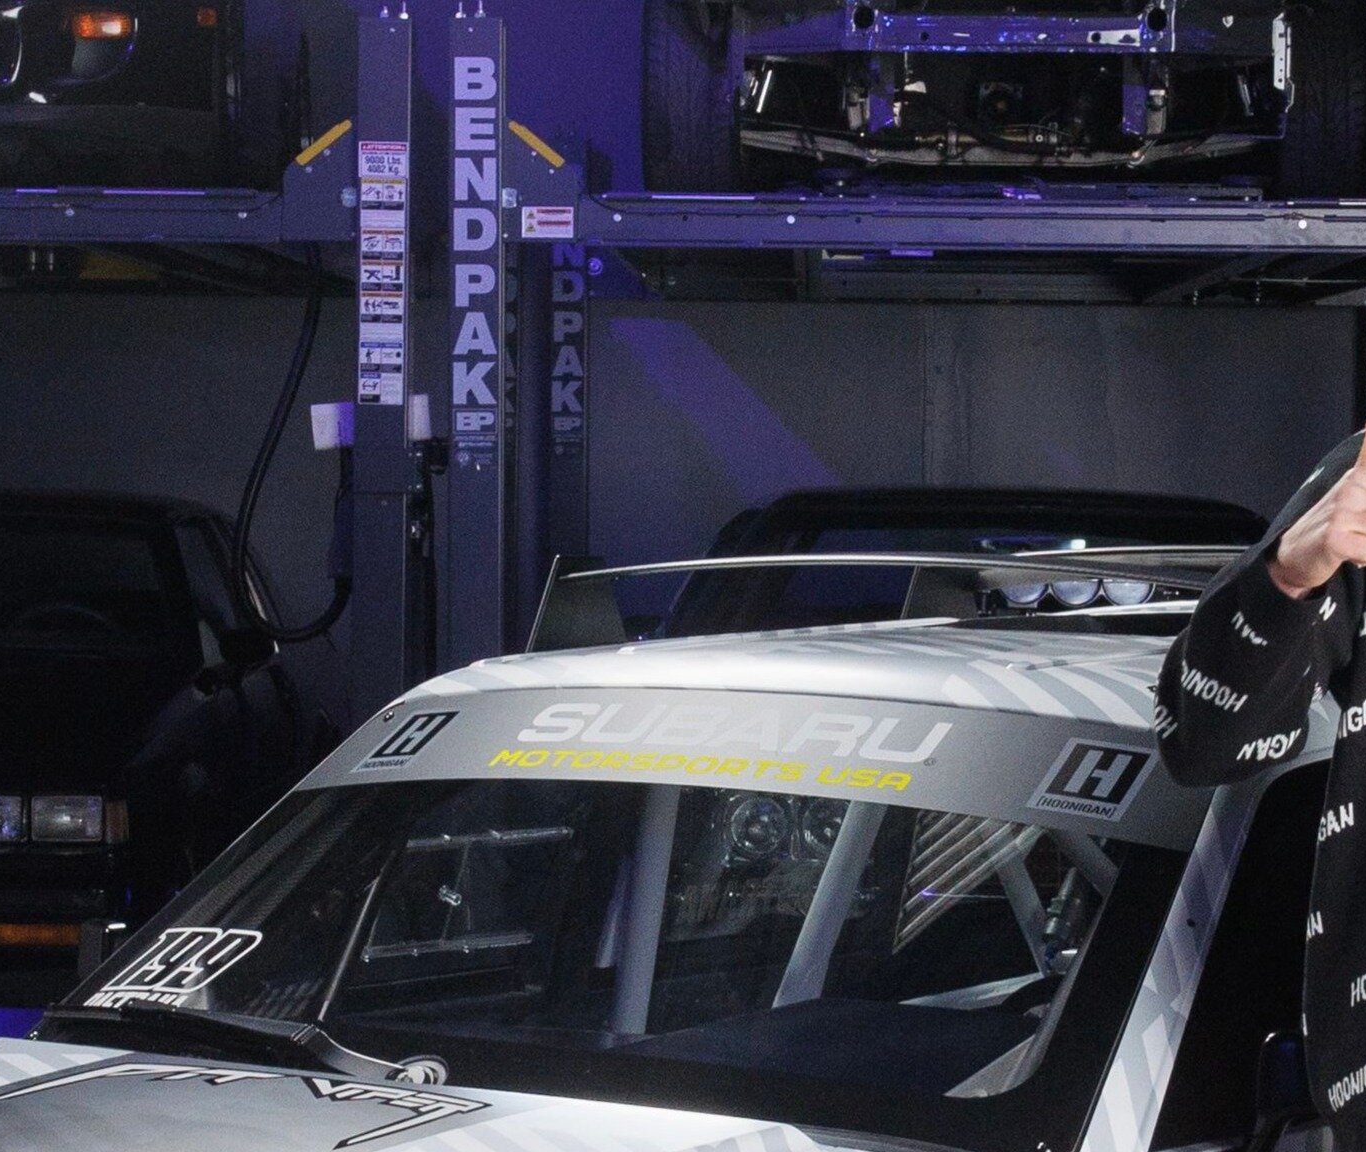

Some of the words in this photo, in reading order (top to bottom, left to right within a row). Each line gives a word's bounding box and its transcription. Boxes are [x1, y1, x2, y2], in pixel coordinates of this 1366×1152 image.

[453, 57, 497, 405] BENDPAK
[517, 702, 953, 765] SUBARU
[488, 748, 808, 782] MOTORSPORTS
[815, 764, 912, 792] USA
